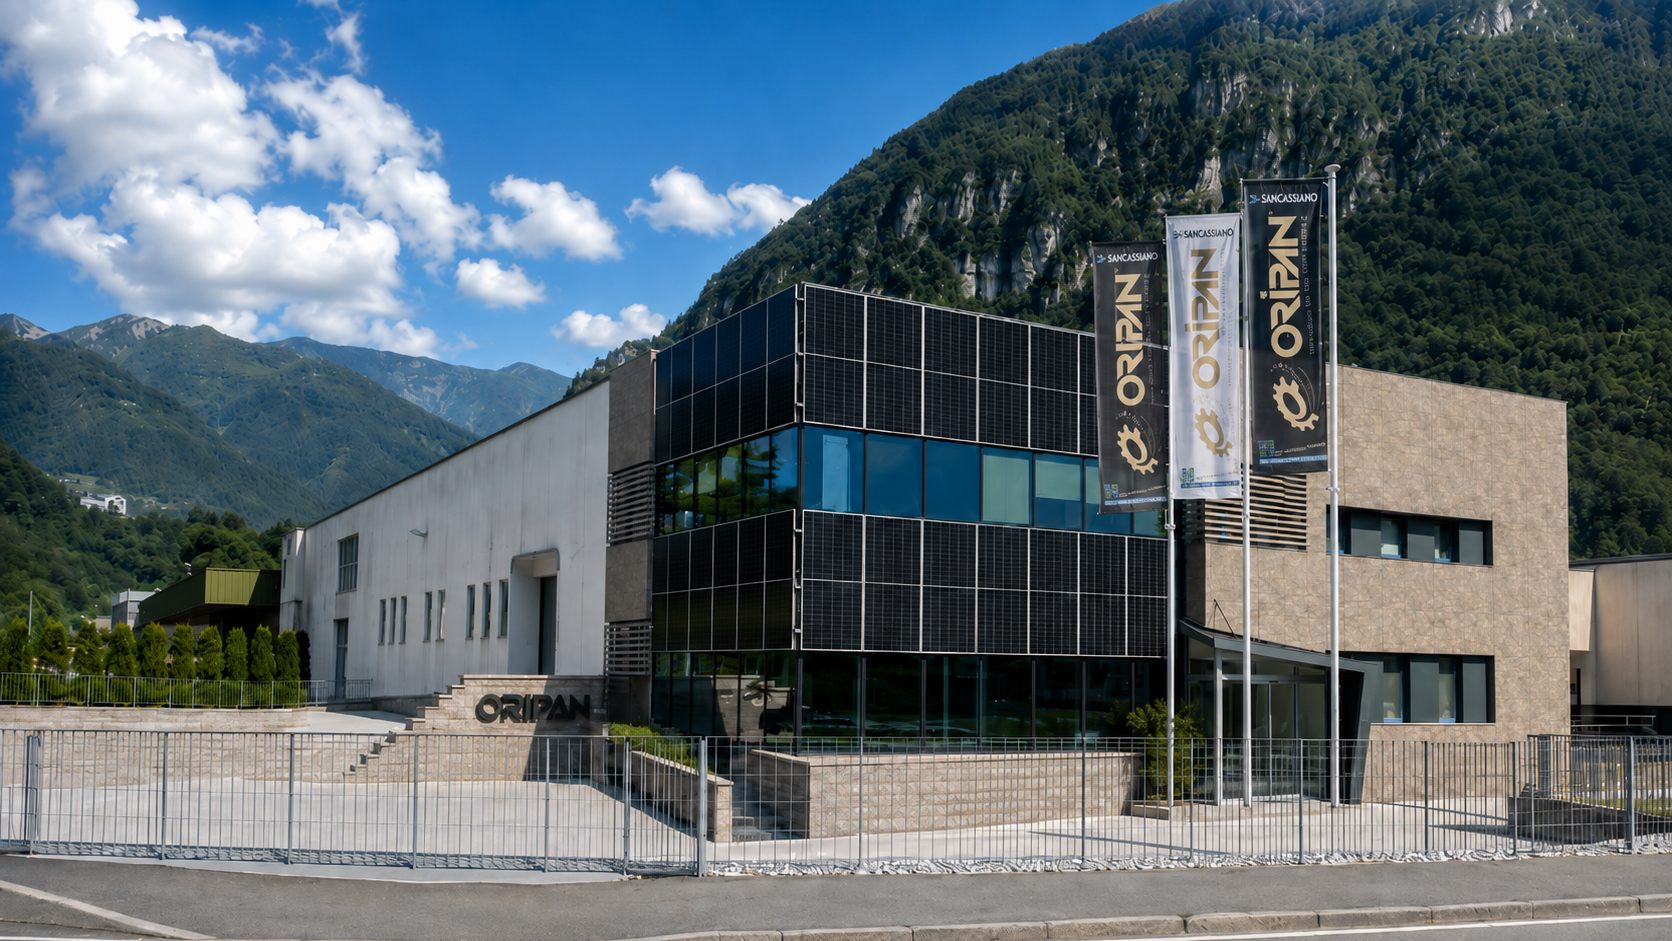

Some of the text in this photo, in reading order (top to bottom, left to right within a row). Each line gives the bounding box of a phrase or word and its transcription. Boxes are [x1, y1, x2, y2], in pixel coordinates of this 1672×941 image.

[1261, 192, 1318, 204] SANCASSIANO
[1184, 228, 1234, 239] SANCASSIANO
[1107, 252, 1158, 263] SANCASSIANO
[1260, 216, 1303, 358] ORIPAN
[1185, 249, 1221, 389] ORIPAN
[1115, 273, 1146, 406] ORIPAN
[475, 694, 591, 724] ORIPAN
